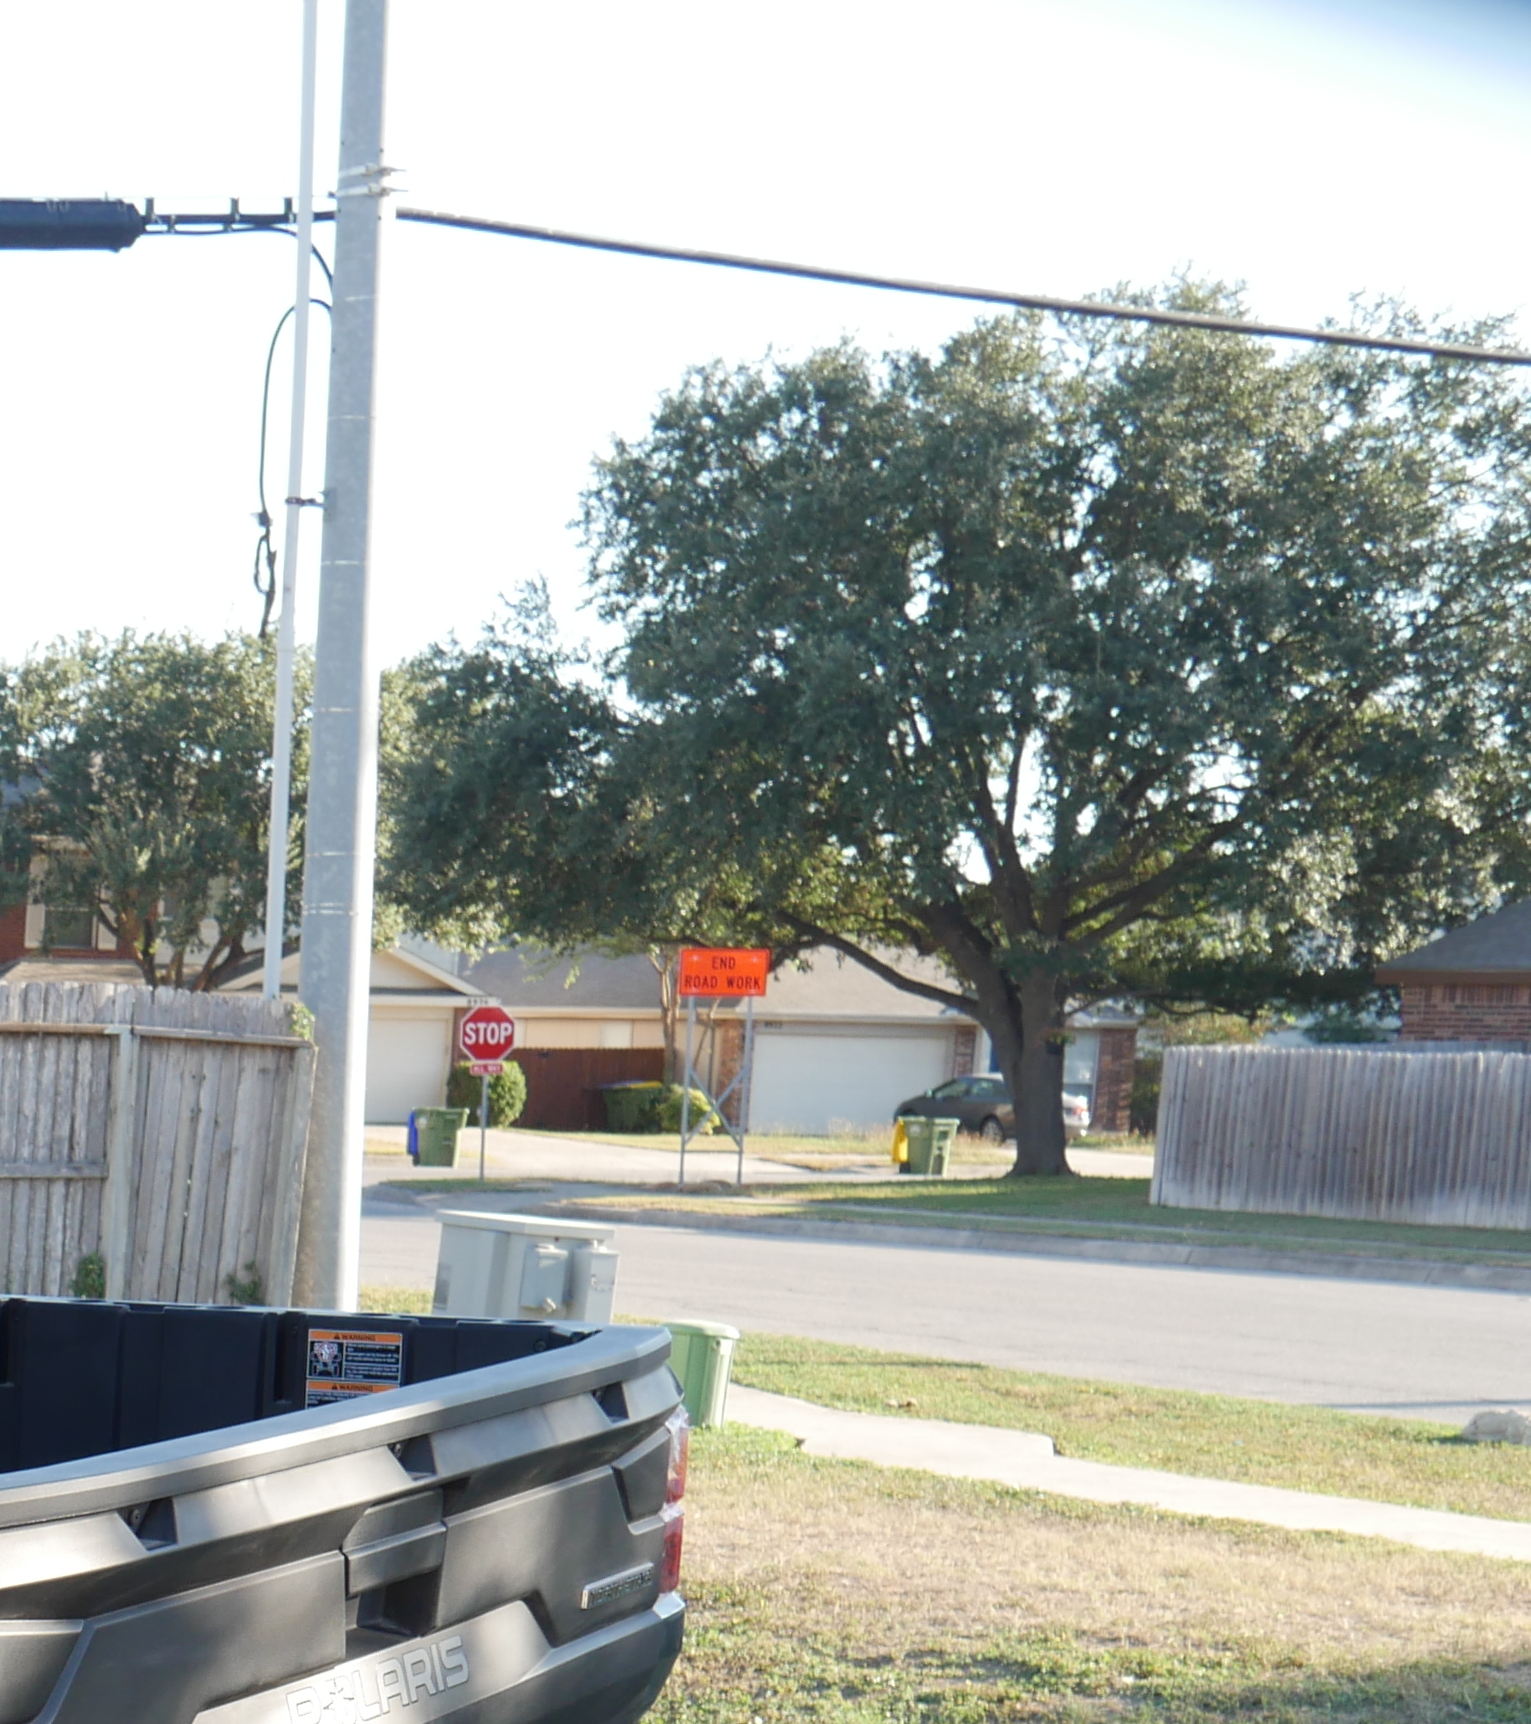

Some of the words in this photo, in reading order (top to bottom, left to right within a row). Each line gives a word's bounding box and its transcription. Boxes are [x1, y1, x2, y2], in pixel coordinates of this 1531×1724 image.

[712, 956, 736, 969] END
[684, 975, 718, 988] ROAD
[726, 976, 761, 989] WORK
[464, 1022, 513, 1045] STOP
